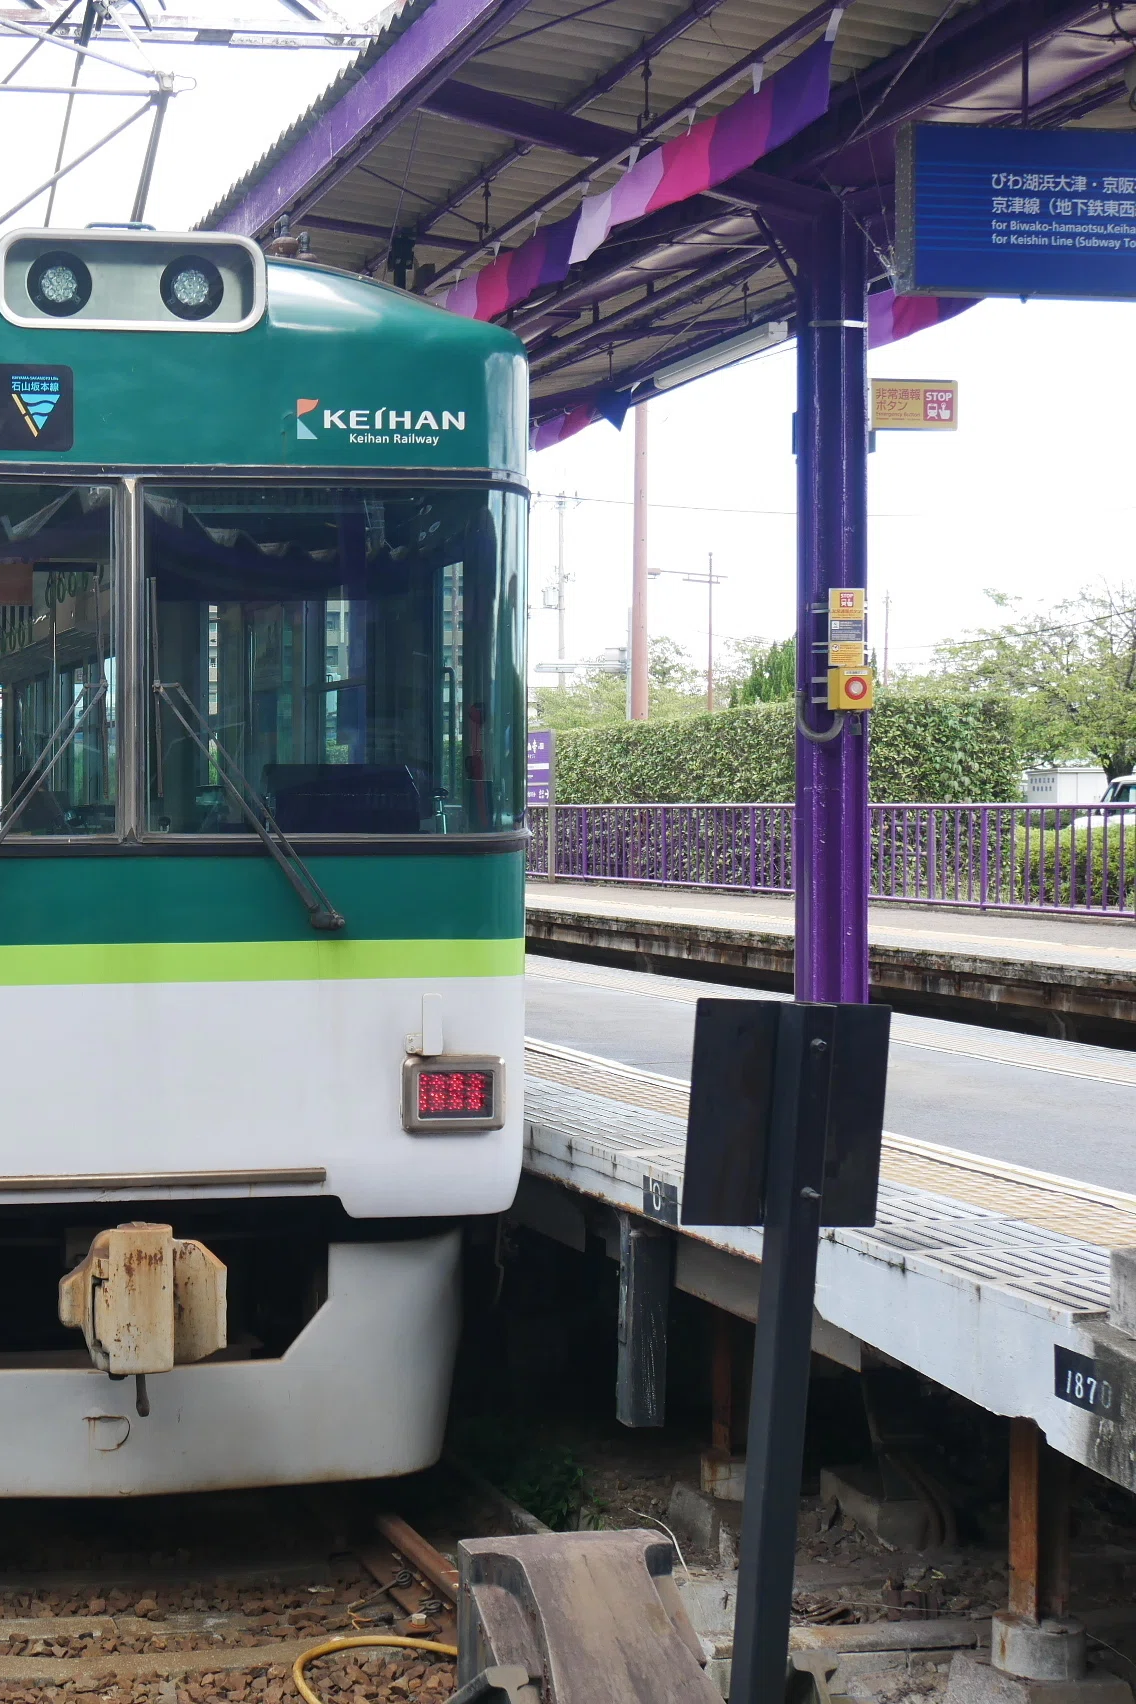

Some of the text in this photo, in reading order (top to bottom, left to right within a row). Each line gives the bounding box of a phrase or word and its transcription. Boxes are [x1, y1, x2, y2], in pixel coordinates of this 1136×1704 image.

[991, 172, 1136, 194] びわ湖浜大津・京阪
[991, 196, 1136, 218] 京津線（地下鉄東西
[991, 219, 1008, 230] for
[991, 233, 1008, 244] for
[1010, 234, 1048, 246] Keishin
[1051, 235, 1073, 246] Line
[1075, 236, 1121, 250] (Subway
[11, 381, 60, 392] 石山坂本線
[876, 388, 921, 401] 非常通報
[925, 392, 953, 401] STOP
[876, 401, 908, 411] ボタン
[323, 407, 466, 431] KEIHAN
[349, 433, 440, 446] Keihan Railway
